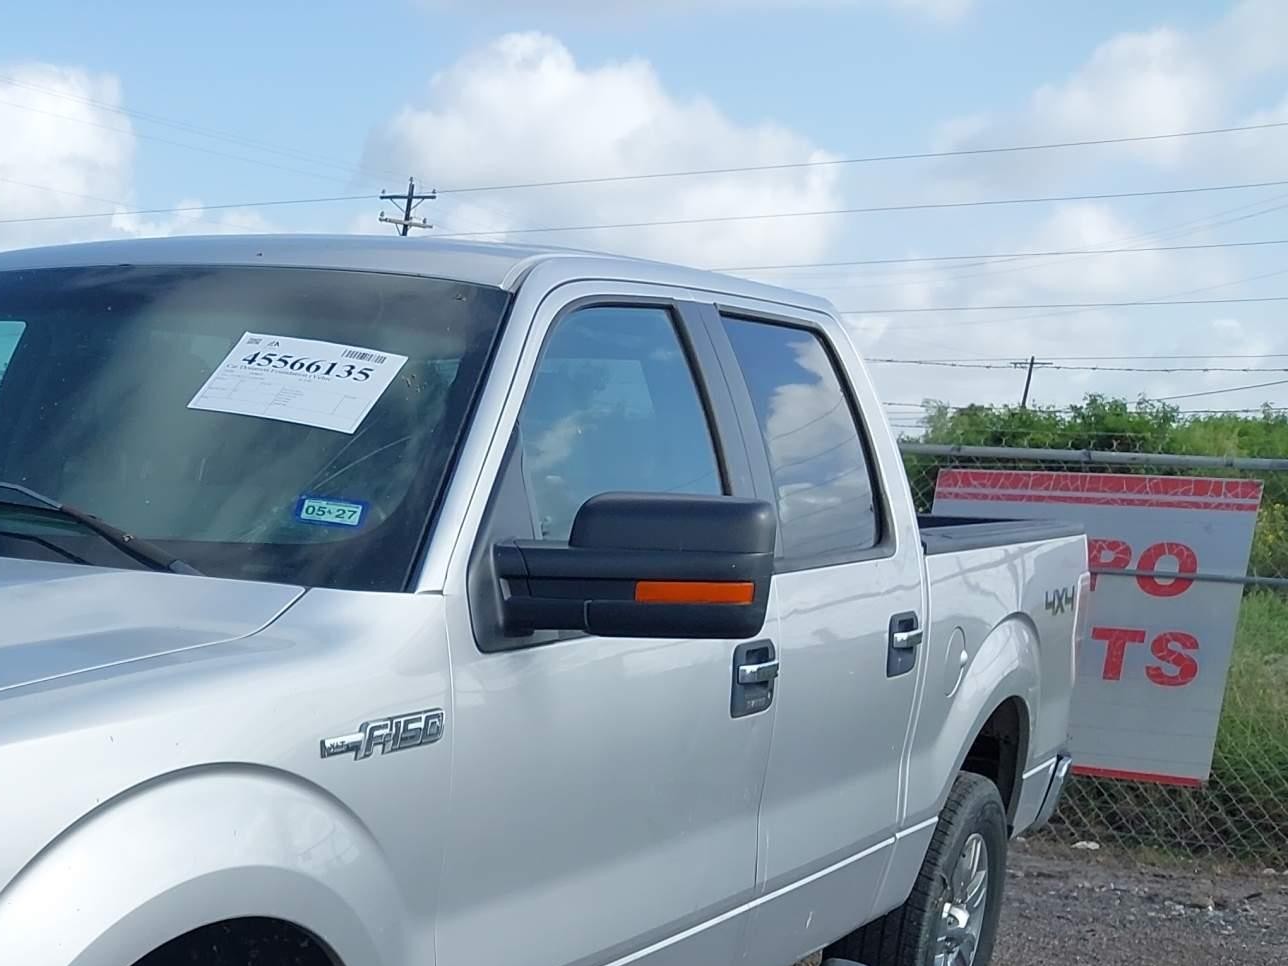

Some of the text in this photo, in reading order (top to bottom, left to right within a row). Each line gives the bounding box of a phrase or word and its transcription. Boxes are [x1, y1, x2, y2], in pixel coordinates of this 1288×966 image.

[242, 351, 375, 382] 45566135
[305, 505, 357, 519] 05 27
